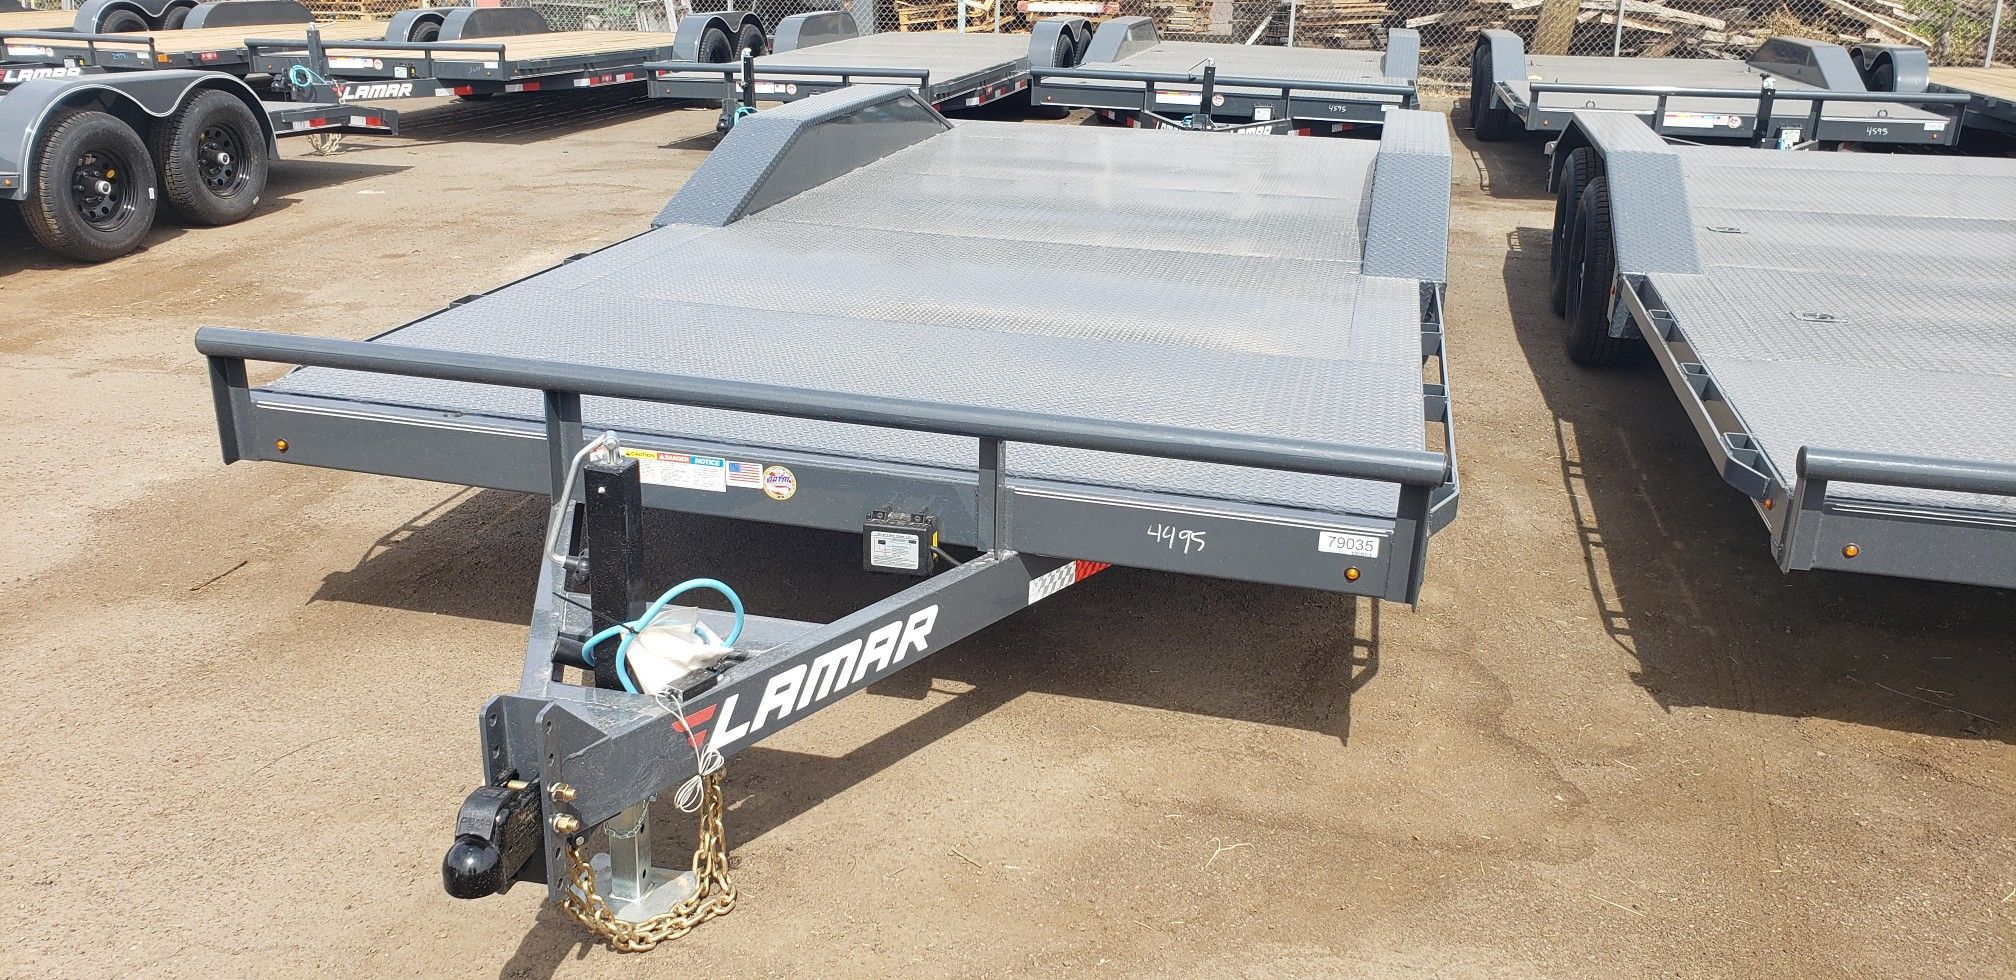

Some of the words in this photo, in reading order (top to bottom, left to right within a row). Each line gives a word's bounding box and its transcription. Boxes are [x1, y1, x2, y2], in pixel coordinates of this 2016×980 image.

[342, 83, 413, 100] LAMAR
[1328, 104, 1346, 113] 4595
[1866, 126, 1888, 136] 4595
[664, 454, 690, 463] DANGER
[694, 457, 721, 467] NOTICE
[1147, 523, 1207, 554] 4495
[1328, 535, 1374, 552] 79035
[704, 603, 939, 752] LAMAR
